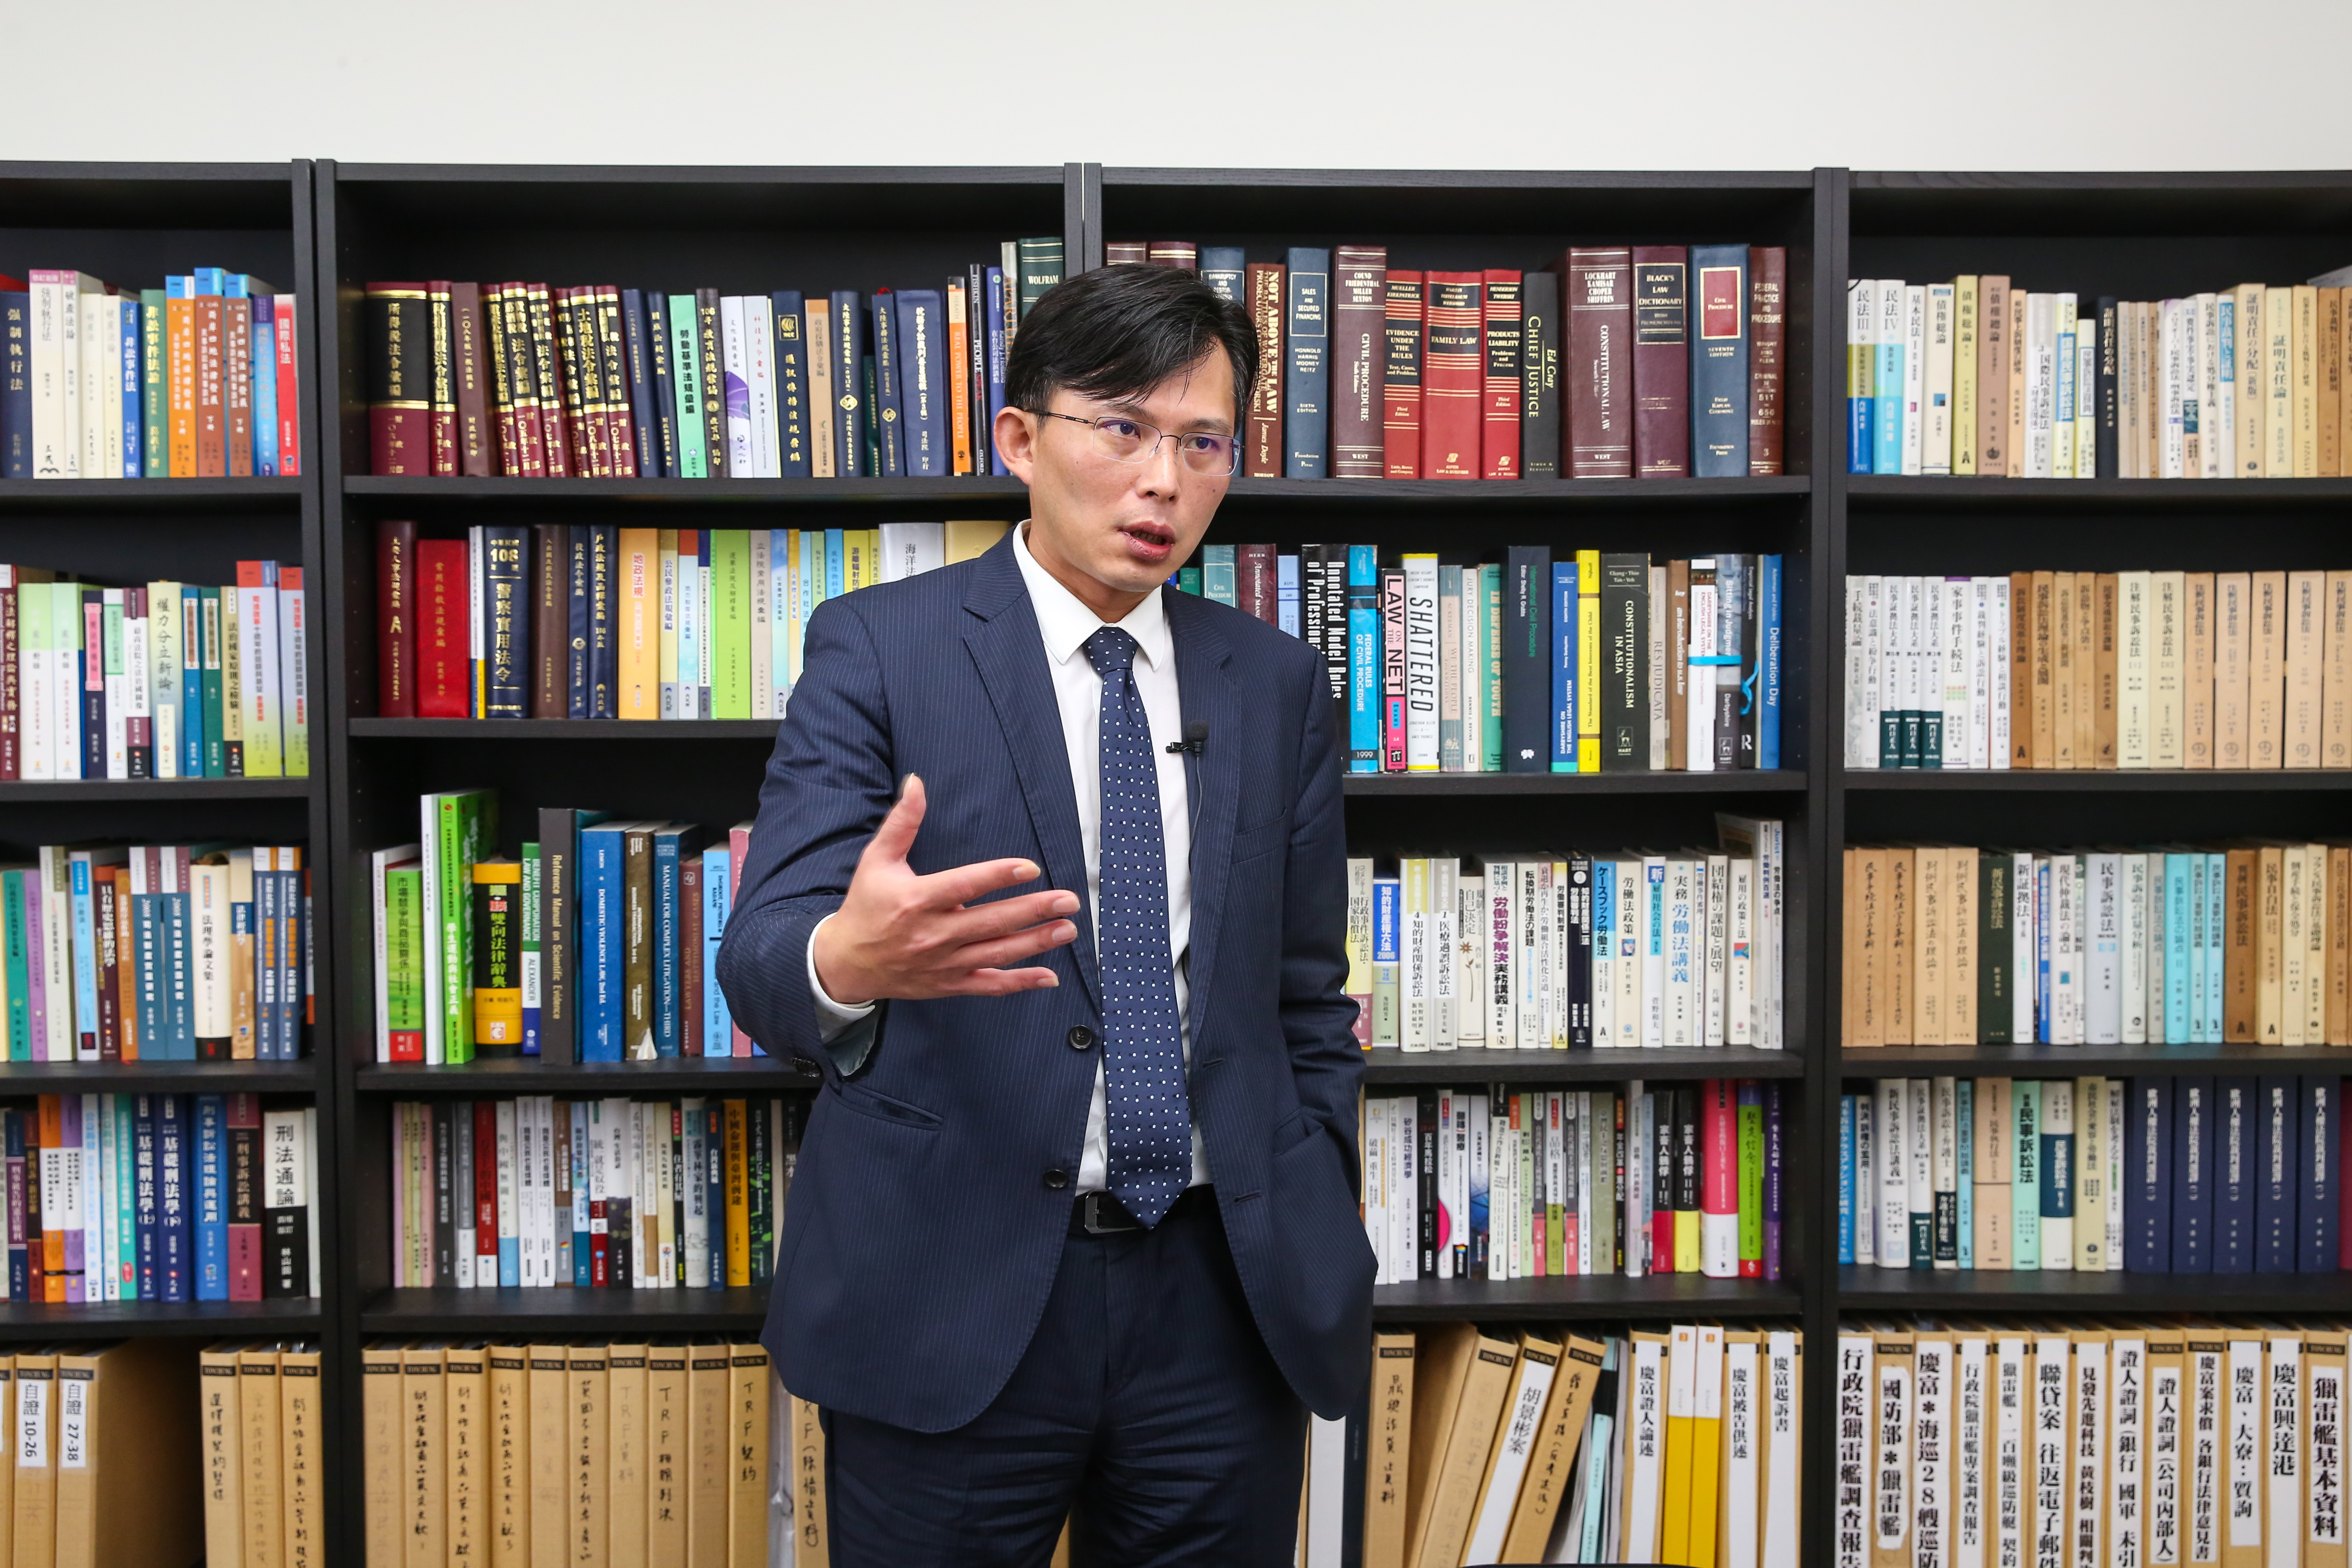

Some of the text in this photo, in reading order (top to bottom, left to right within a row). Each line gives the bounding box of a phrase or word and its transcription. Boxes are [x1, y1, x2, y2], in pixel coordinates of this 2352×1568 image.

[1028, 275, 1059, 285] WOLFRAM
[1268, 271, 1279, 303] NOT
[1267, 306, 1279, 358] ABOVE
[1526, 316, 1541, 417] CHIEF JUSTICE
[1547, 349, 1556, 362] Ed
[1600, 324, 1610, 410] CONSTITUTIONAL
[956, 383, 962, 393] TO
[1266, 378, 1277, 414] LAW
[1360, 333, 1370, 421] CIVIL PROCEDURE
[490, 549, 519, 562] 108
[1307, 561, 1325, 576] of
[1254, 561, 1263, 599] Annotated
[1387, 578, 1402, 624] LAW
[495, 583, 512, 683] 警察實用法令
[1327, 561, 1346, 699] Annotated Model Rules
[1356, 634, 1364, 644] OF
[1395, 630, 1402, 643] ON
[1615, 636, 1623, 647] IN
[1388, 649, 1403, 691] NET
[1409, 597, 1433, 712] SHATTERED
[1625, 600, 1634, 708] CONSTITUTIONALISM
[1767, 627, 1779, 707] Deliberation Day
[1653, 664, 1662, 720] JUDICATA
[552, 855, 563, 1019] Reference Manual on Scientific Evidence
[24, 1421, 37, 1458] 10-26
[67, 1423, 79, 1461] 27-38
